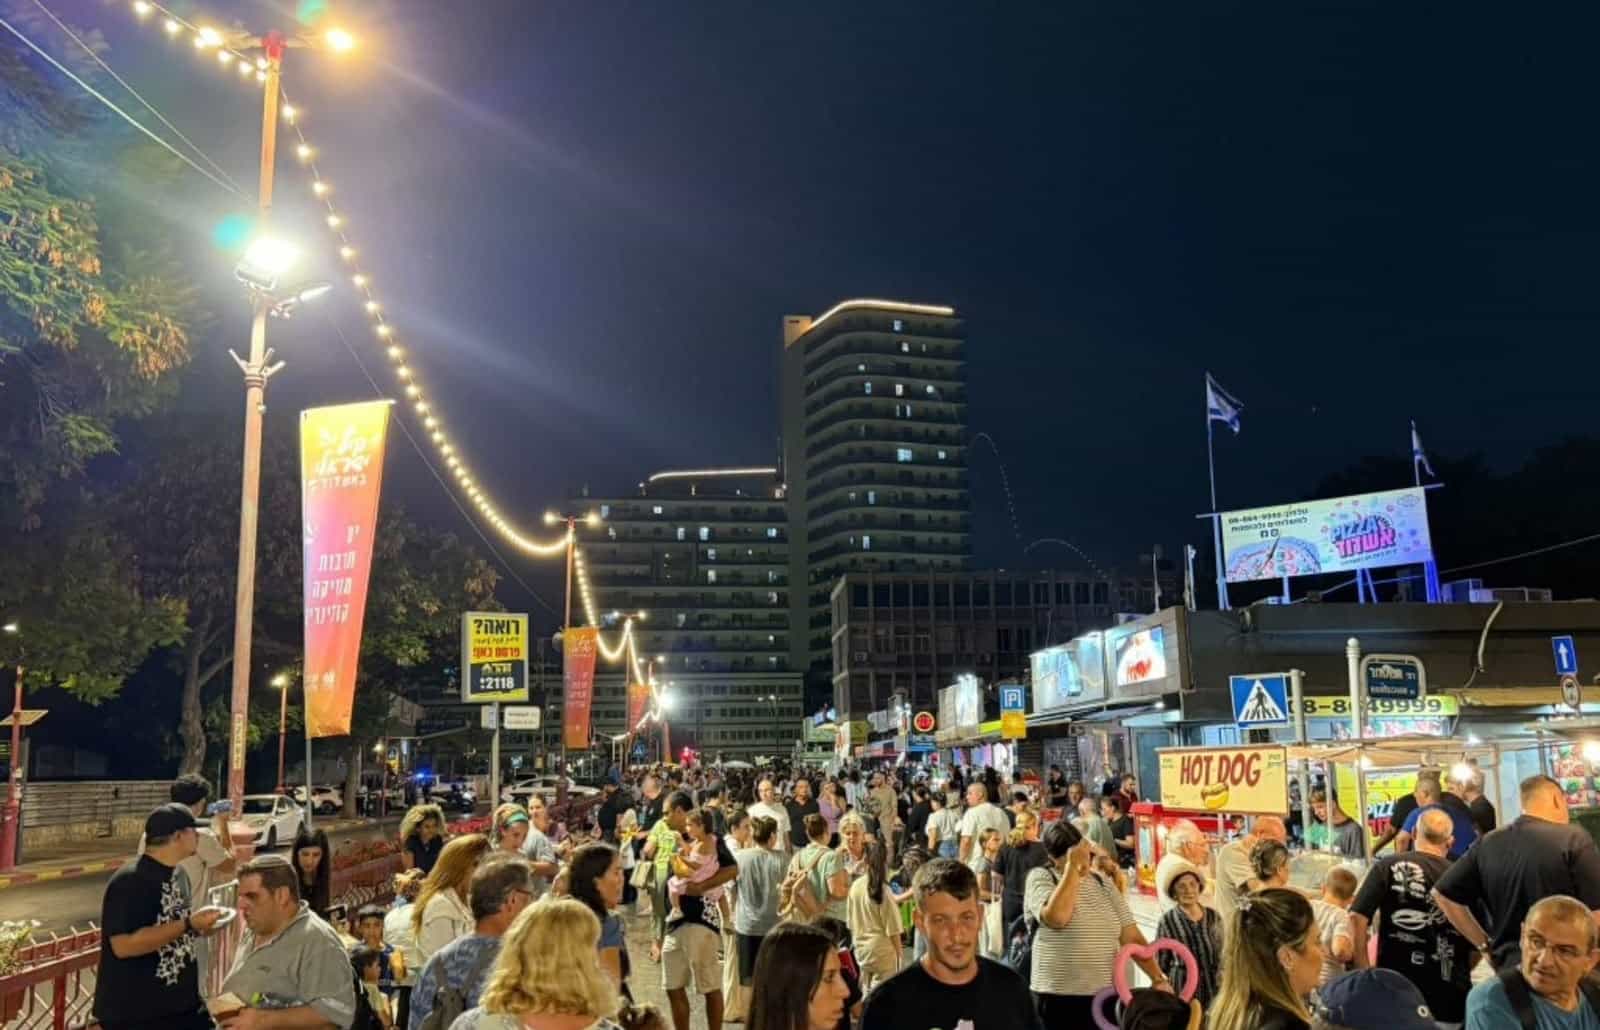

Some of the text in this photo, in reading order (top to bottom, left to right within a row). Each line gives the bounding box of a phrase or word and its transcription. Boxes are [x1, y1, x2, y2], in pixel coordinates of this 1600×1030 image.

[1336, 527, 1396, 558] אשדוד
[319, 550, 357, 571] תרבות
[473, 618, 520, 635] רואה?
[1180, 754, 1214, 786] HOT
[1217, 751, 1262, 787] DOG
